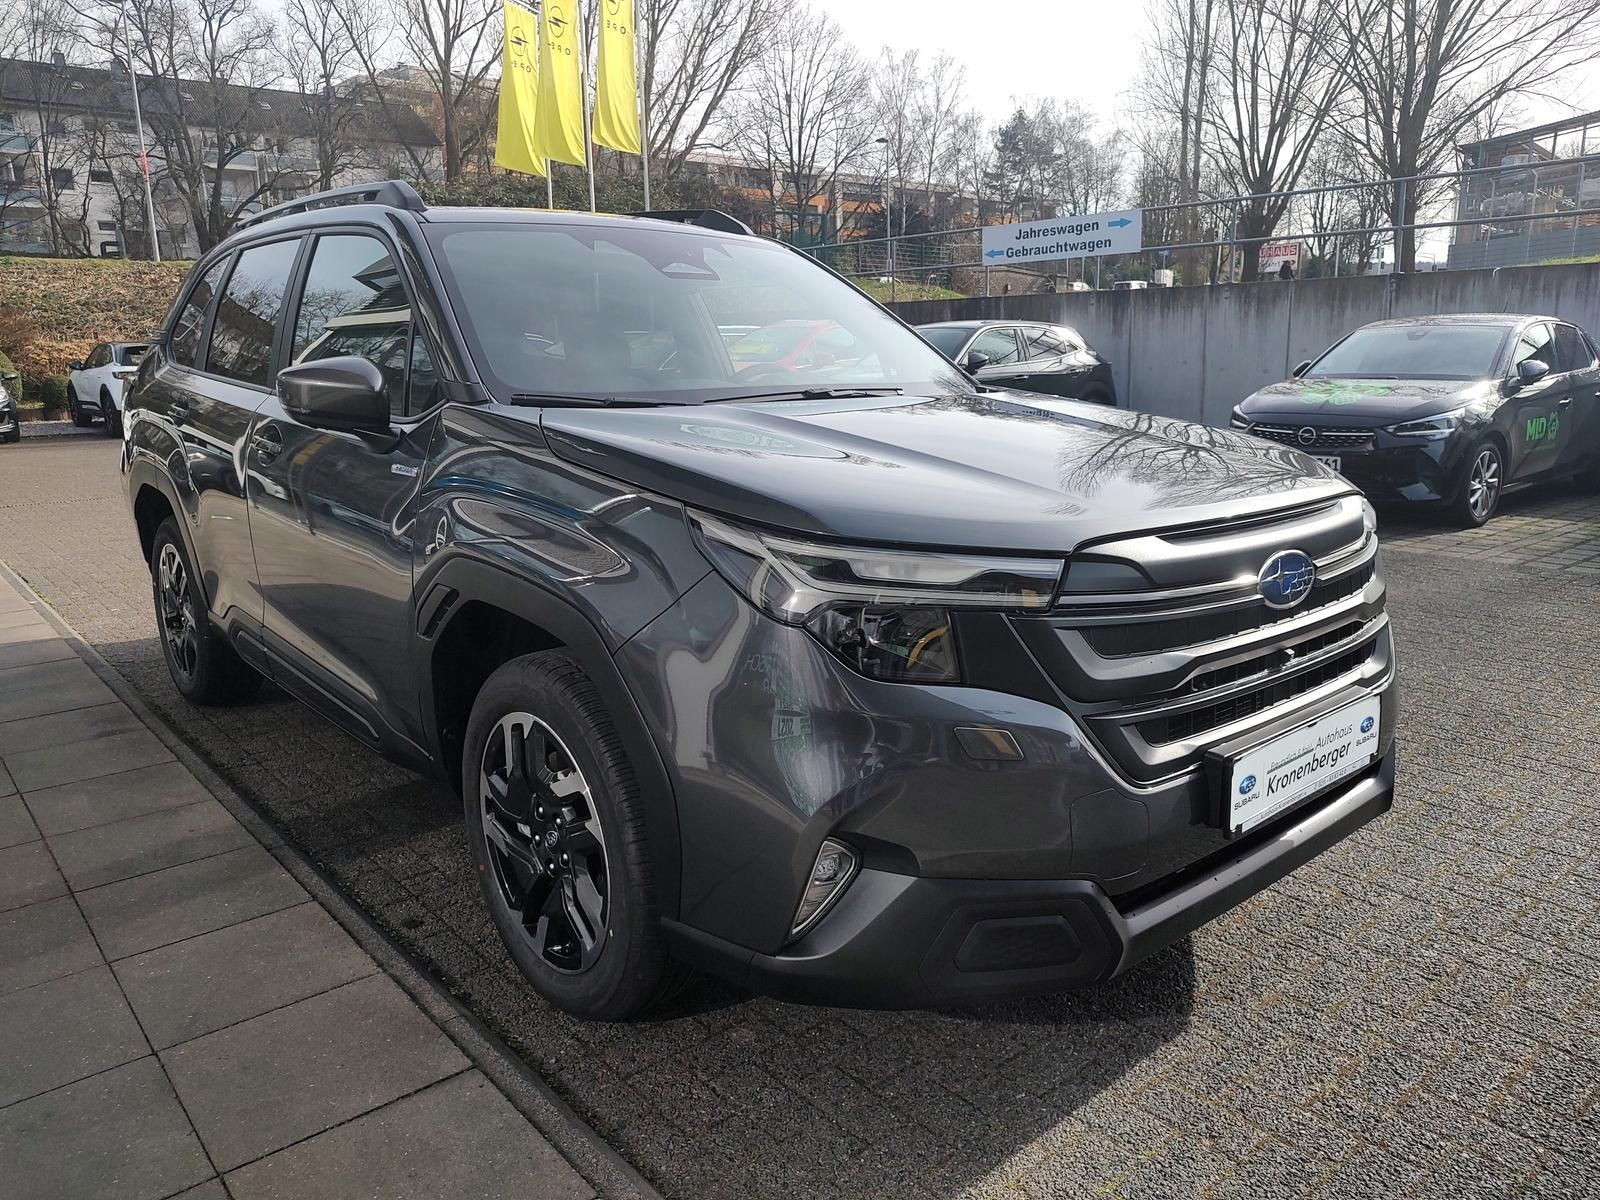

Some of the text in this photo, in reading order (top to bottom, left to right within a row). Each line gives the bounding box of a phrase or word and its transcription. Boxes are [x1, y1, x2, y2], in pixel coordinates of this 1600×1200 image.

[1015, 221, 1099, 240] Jahreswagen
[1006, 238, 1111, 258] Gebrauchtwagen
[1317, 457, 1339, 472] 61
[1314, 722, 1353, 749] Autohaus
[1355, 731, 1378, 747] SUBARU
[1265, 740, 1352, 798] Kronenberger
[1234, 791, 1261, 811] SUBARU
